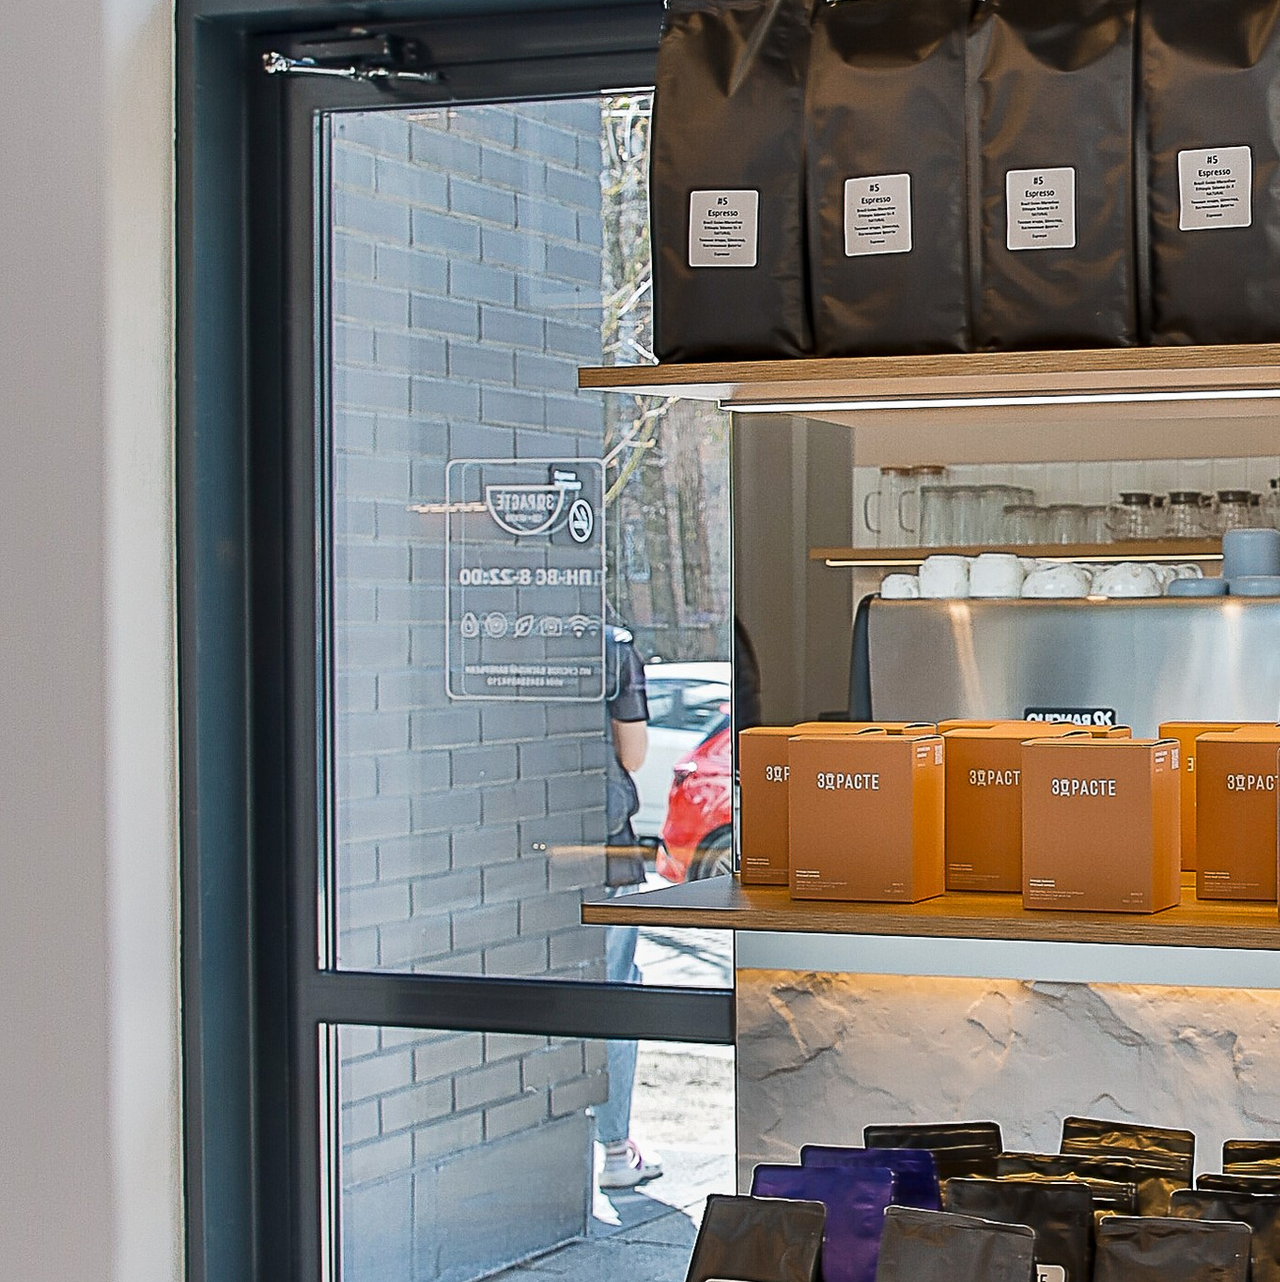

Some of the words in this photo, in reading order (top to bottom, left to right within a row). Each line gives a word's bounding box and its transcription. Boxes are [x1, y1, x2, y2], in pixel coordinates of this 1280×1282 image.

[1198, 168, 1231, 178] Espresso
[1025, 190, 1055, 198] Espresso
[861, 196, 891, 205] Espresso
[708, 209, 739, 218] Espresso
[969, 769, 1021, 786] ЗДРАСТ
